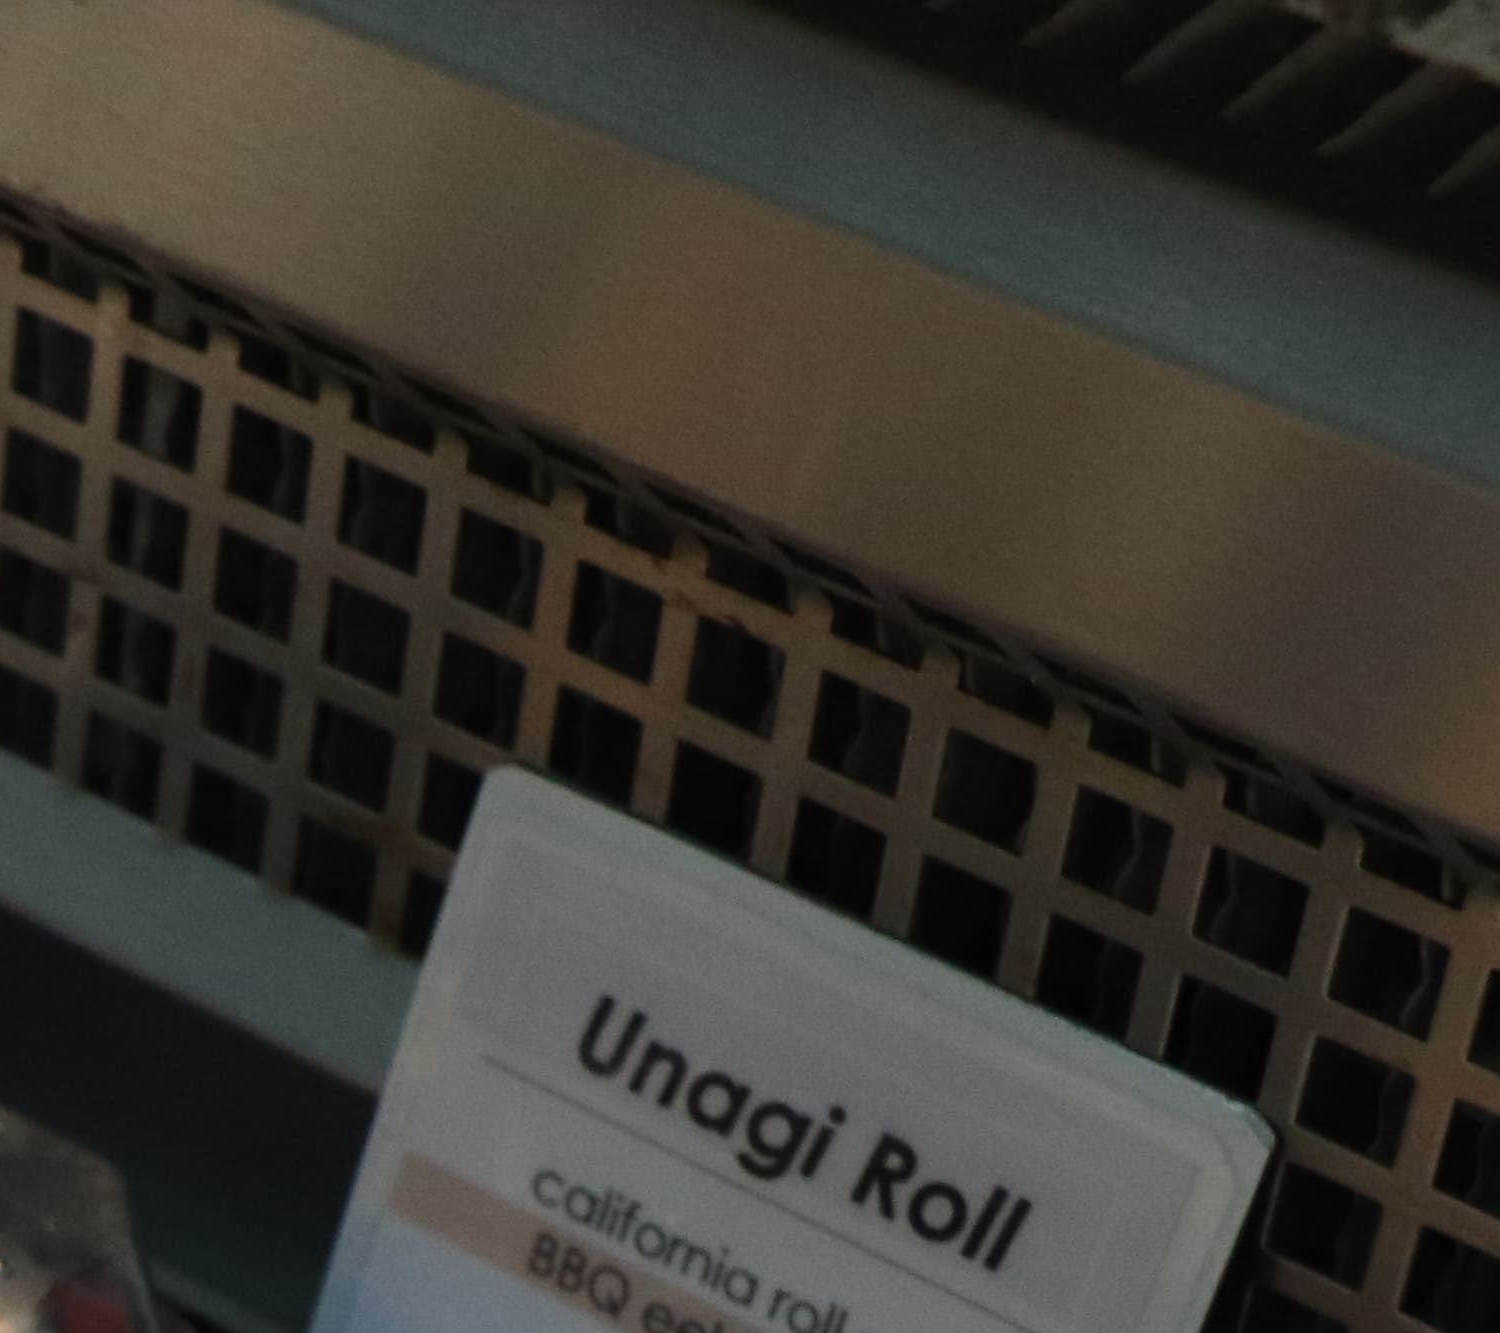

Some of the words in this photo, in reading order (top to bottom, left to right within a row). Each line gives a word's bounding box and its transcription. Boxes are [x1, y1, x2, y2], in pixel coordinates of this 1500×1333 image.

[576, 993, 848, 1184] Unagi
[850, 1132, 1033, 1273] Roll
[527, 1231, 632, 1316] BBQ
[531, 1165, 762, 1310] california
